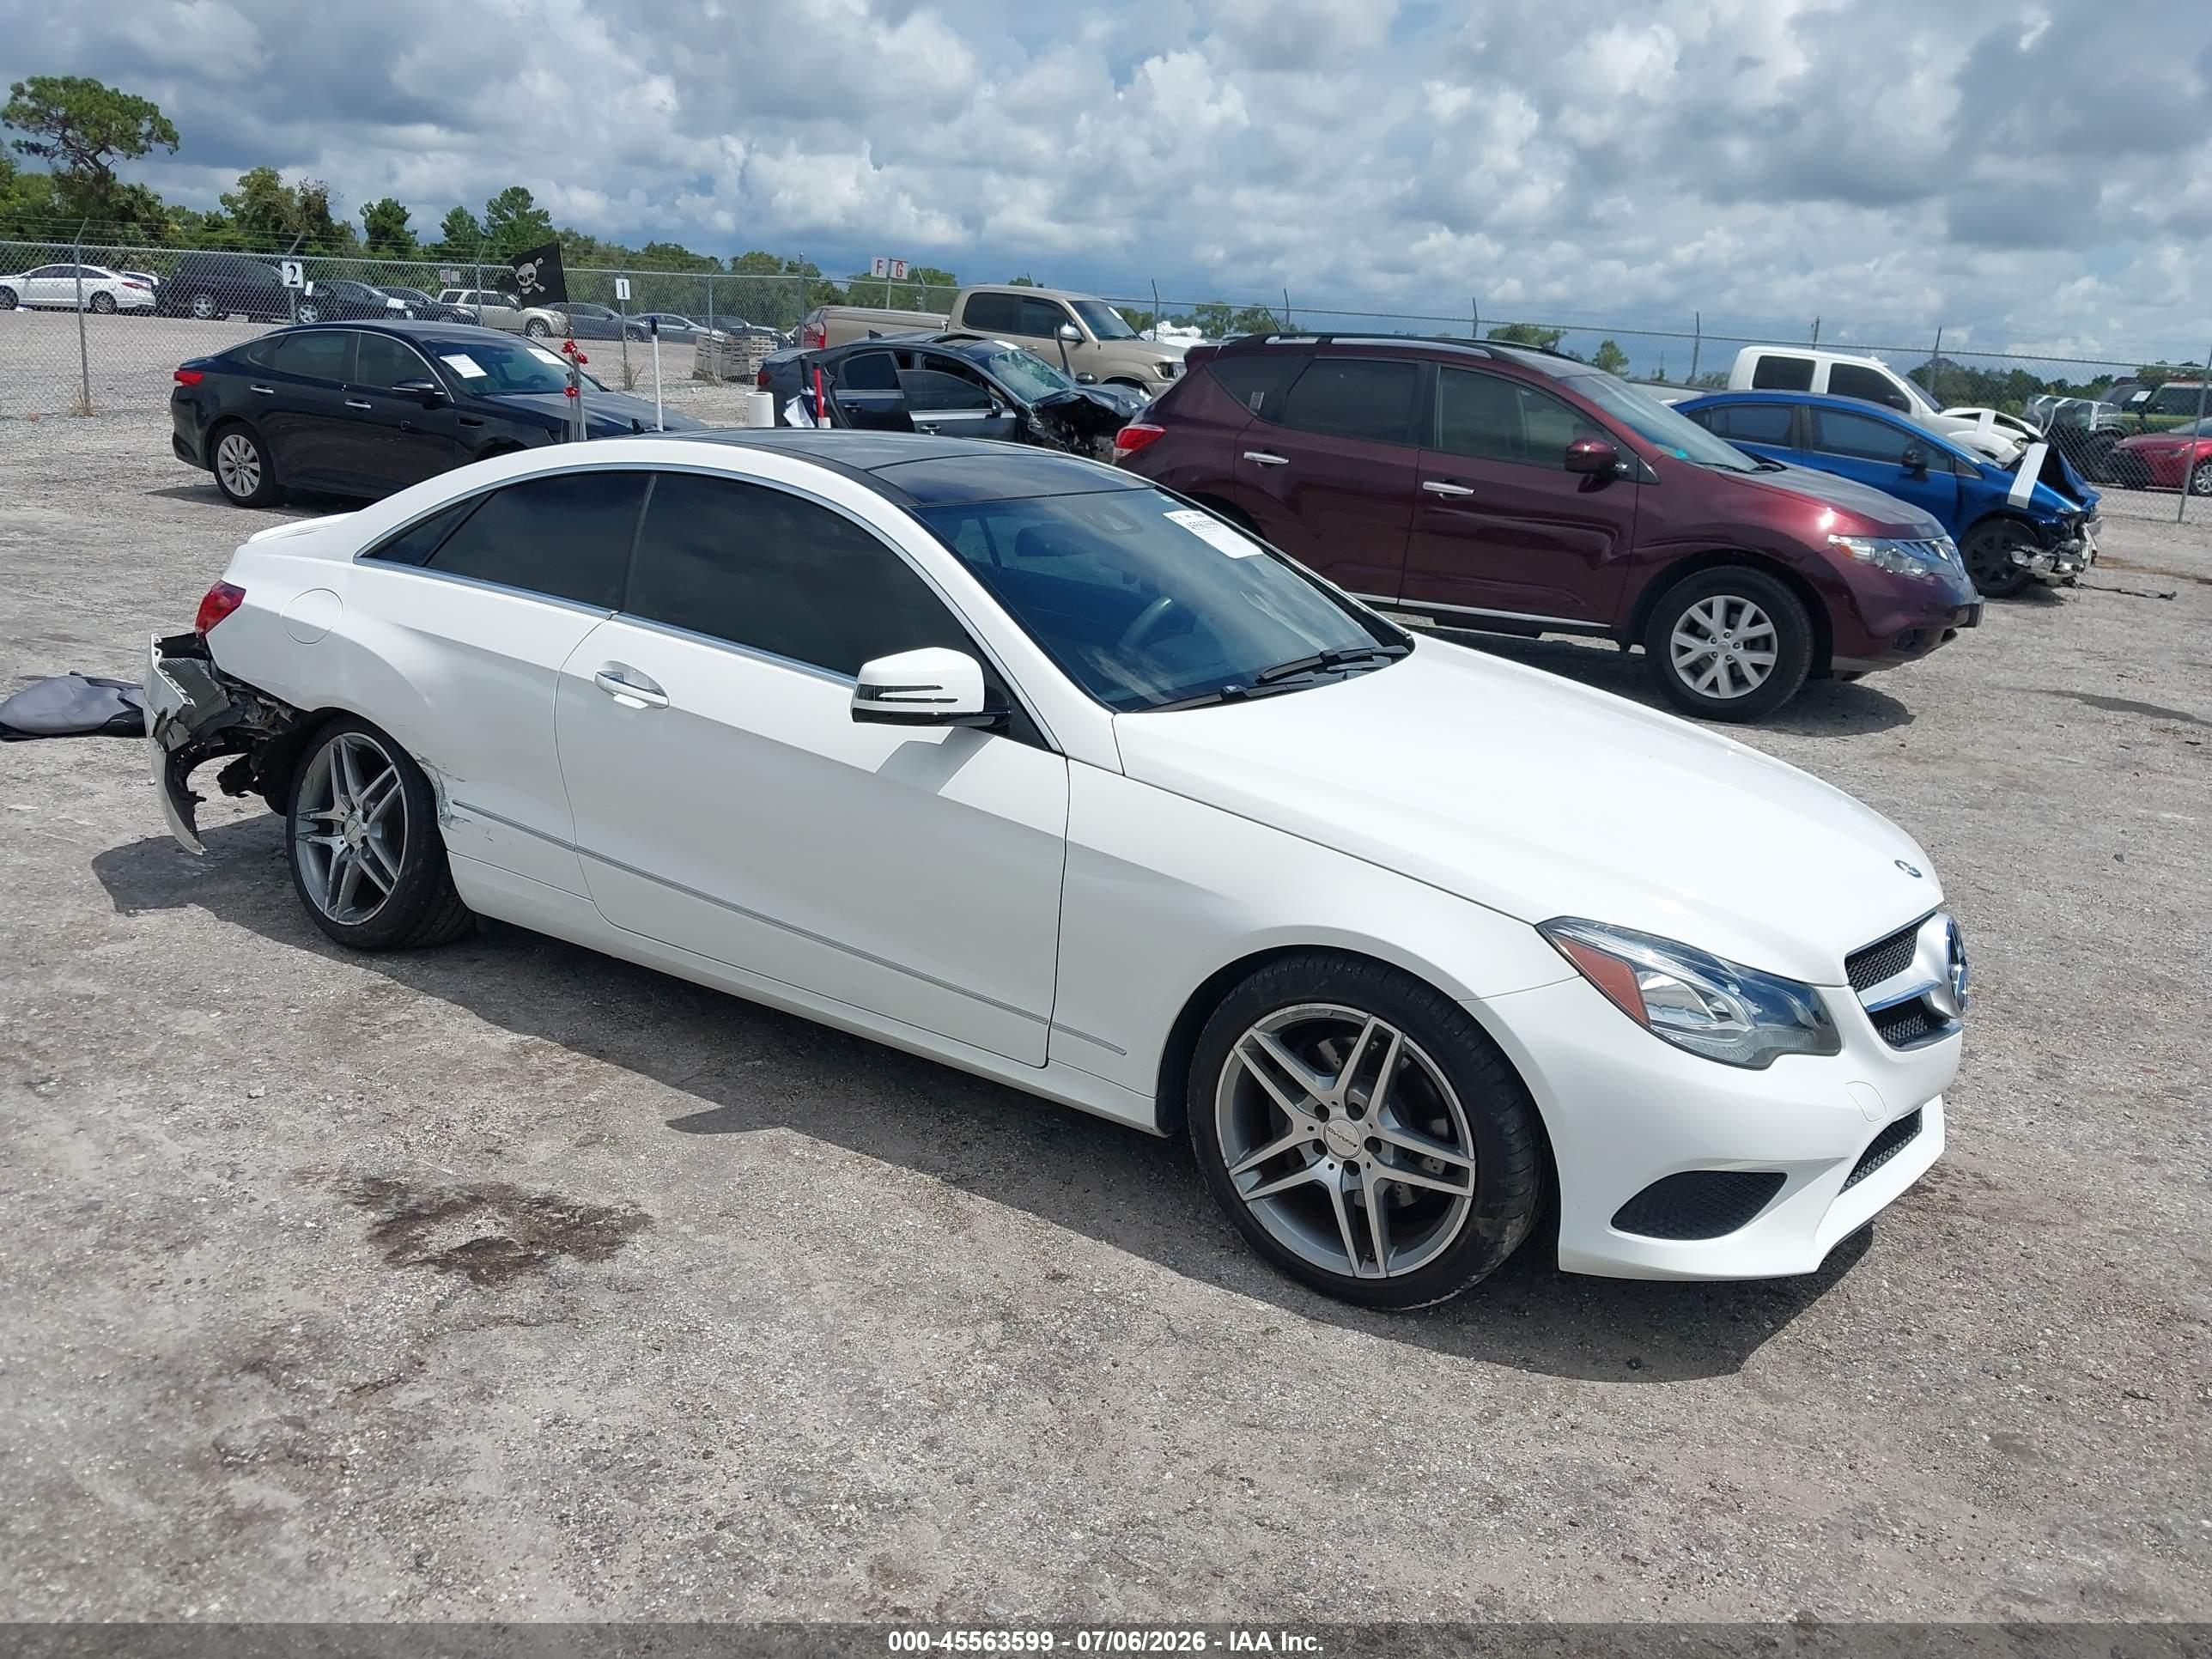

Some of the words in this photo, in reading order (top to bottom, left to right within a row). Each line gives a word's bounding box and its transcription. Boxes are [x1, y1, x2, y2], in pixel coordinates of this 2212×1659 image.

[288, 264, 298, 285] 2
[876, 259, 883, 275] F
[896, 261, 903, 277] G
